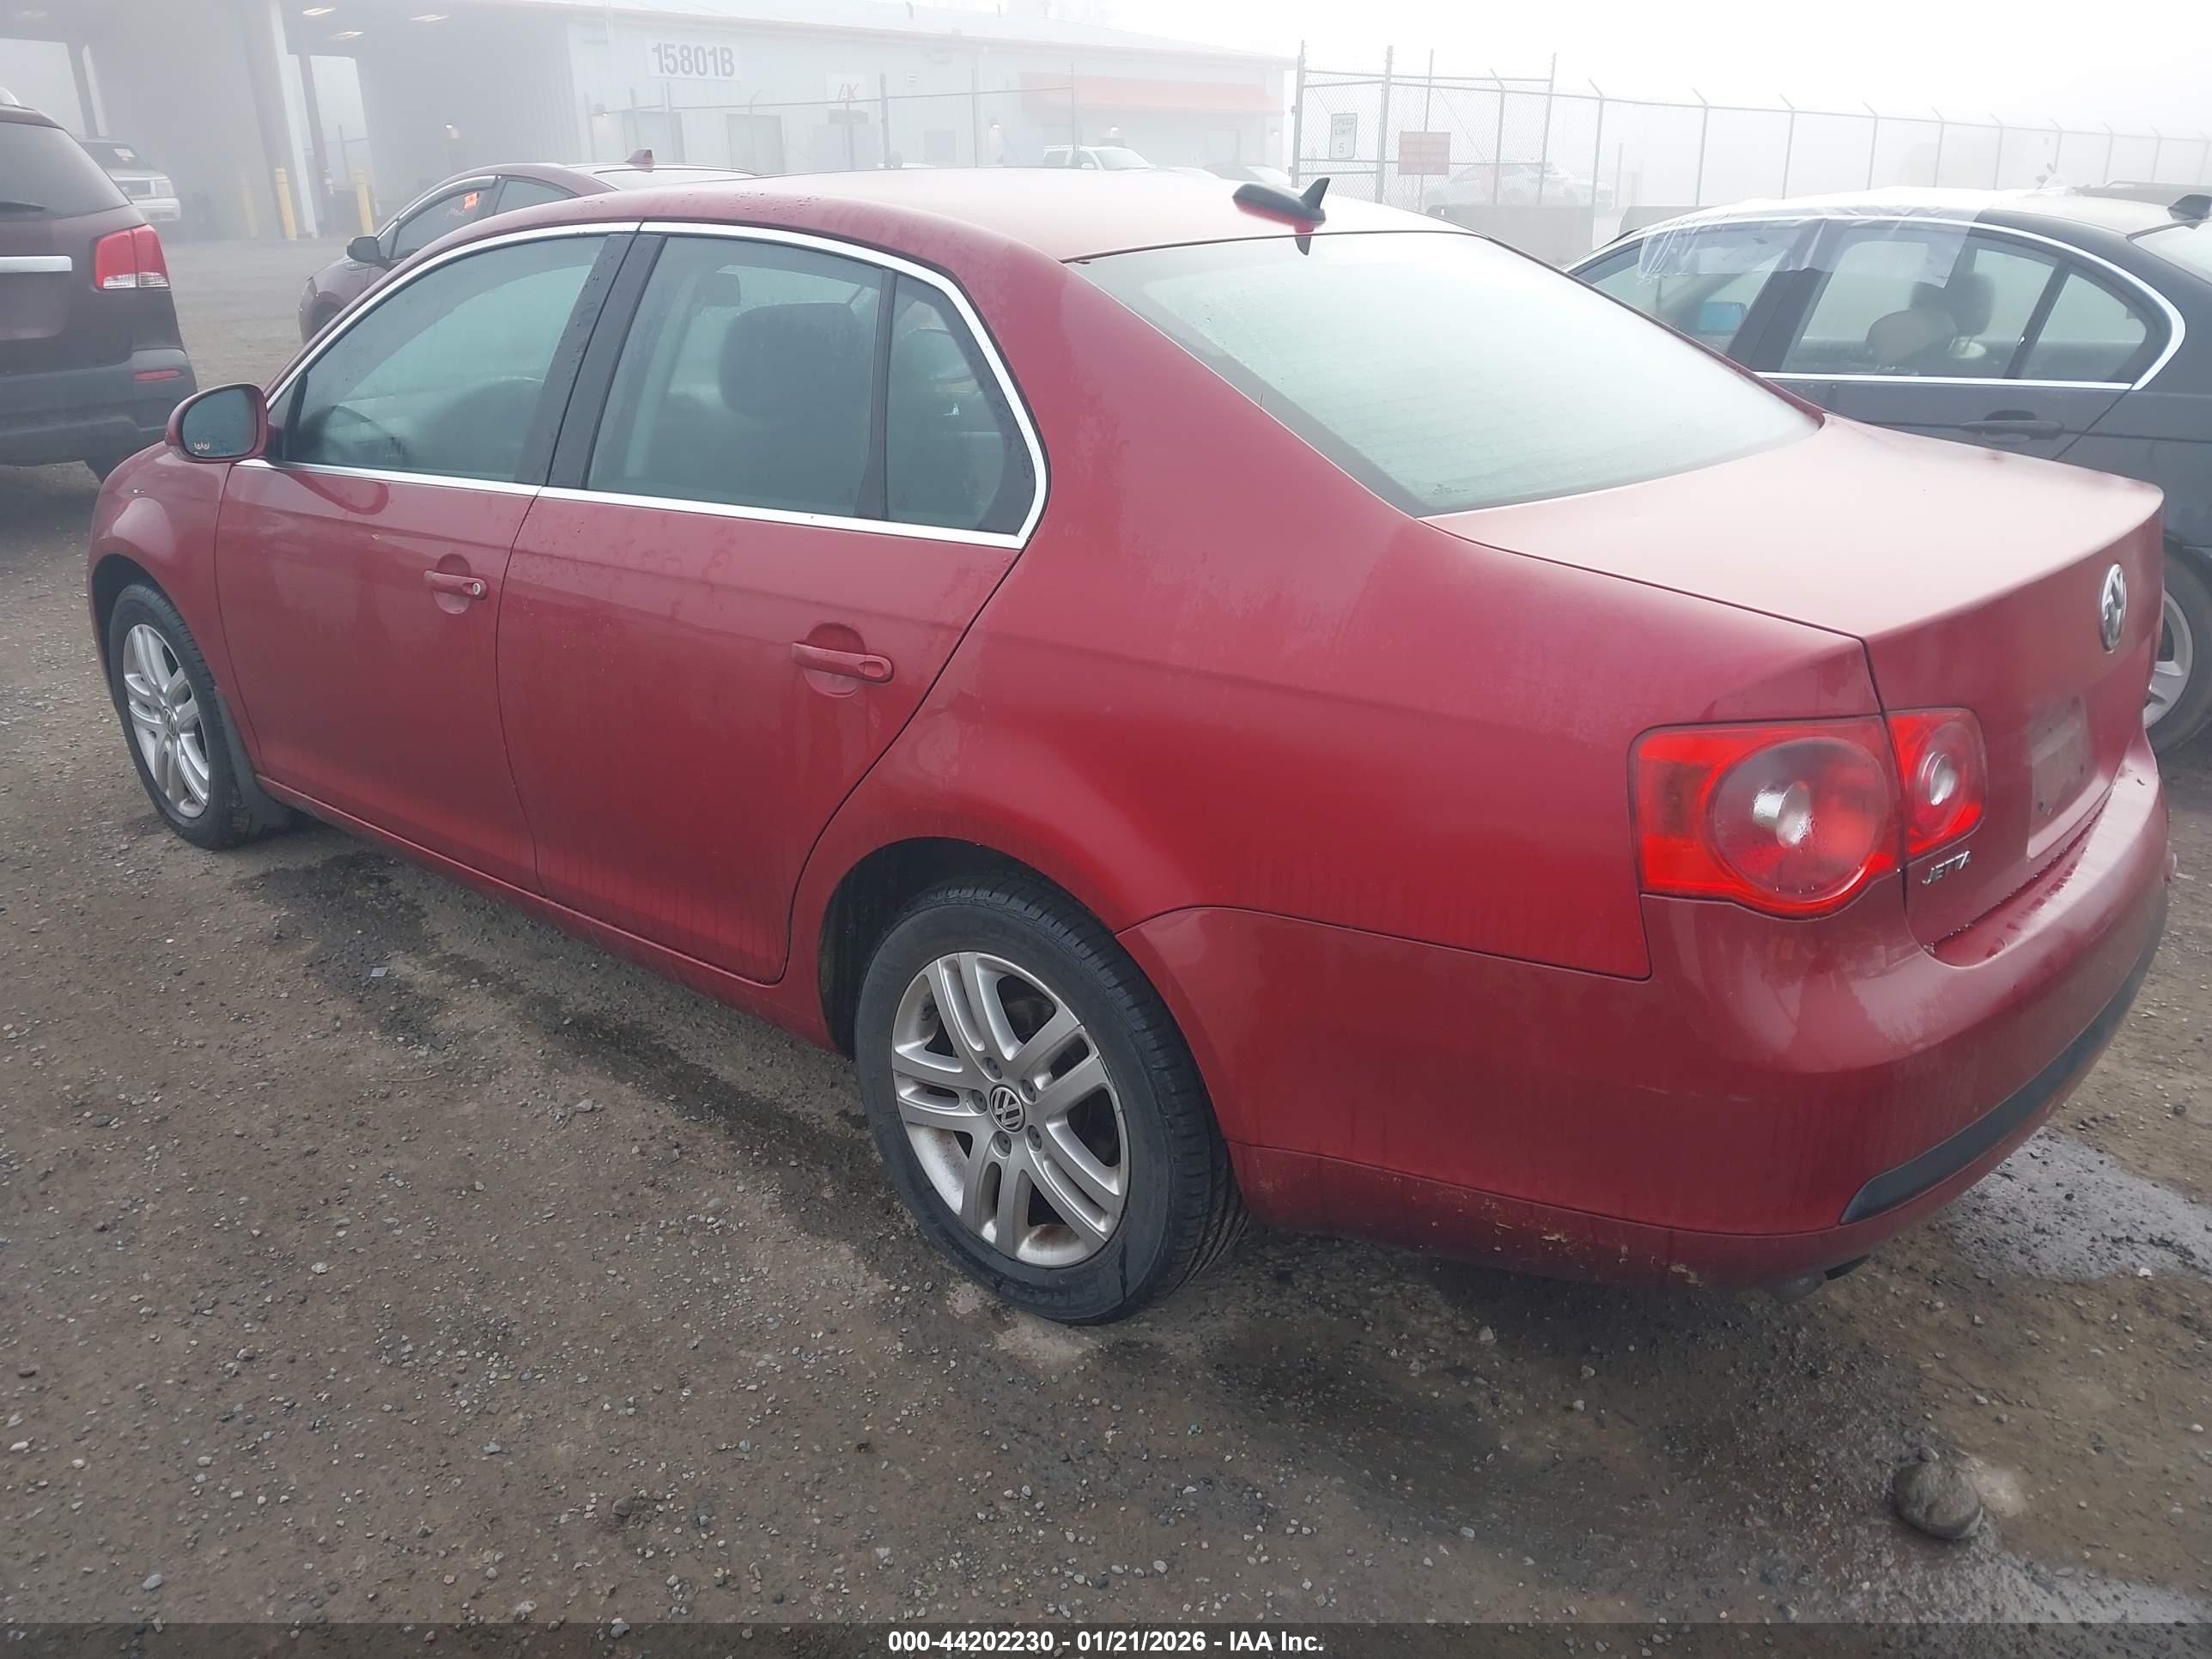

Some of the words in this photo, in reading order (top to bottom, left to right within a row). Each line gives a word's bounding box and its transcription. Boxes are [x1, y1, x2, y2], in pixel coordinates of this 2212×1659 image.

[652, 43, 735, 77] 15801B
[1334, 127, 1352, 136] LIMIT
[1339, 143, 1345, 153] 5
